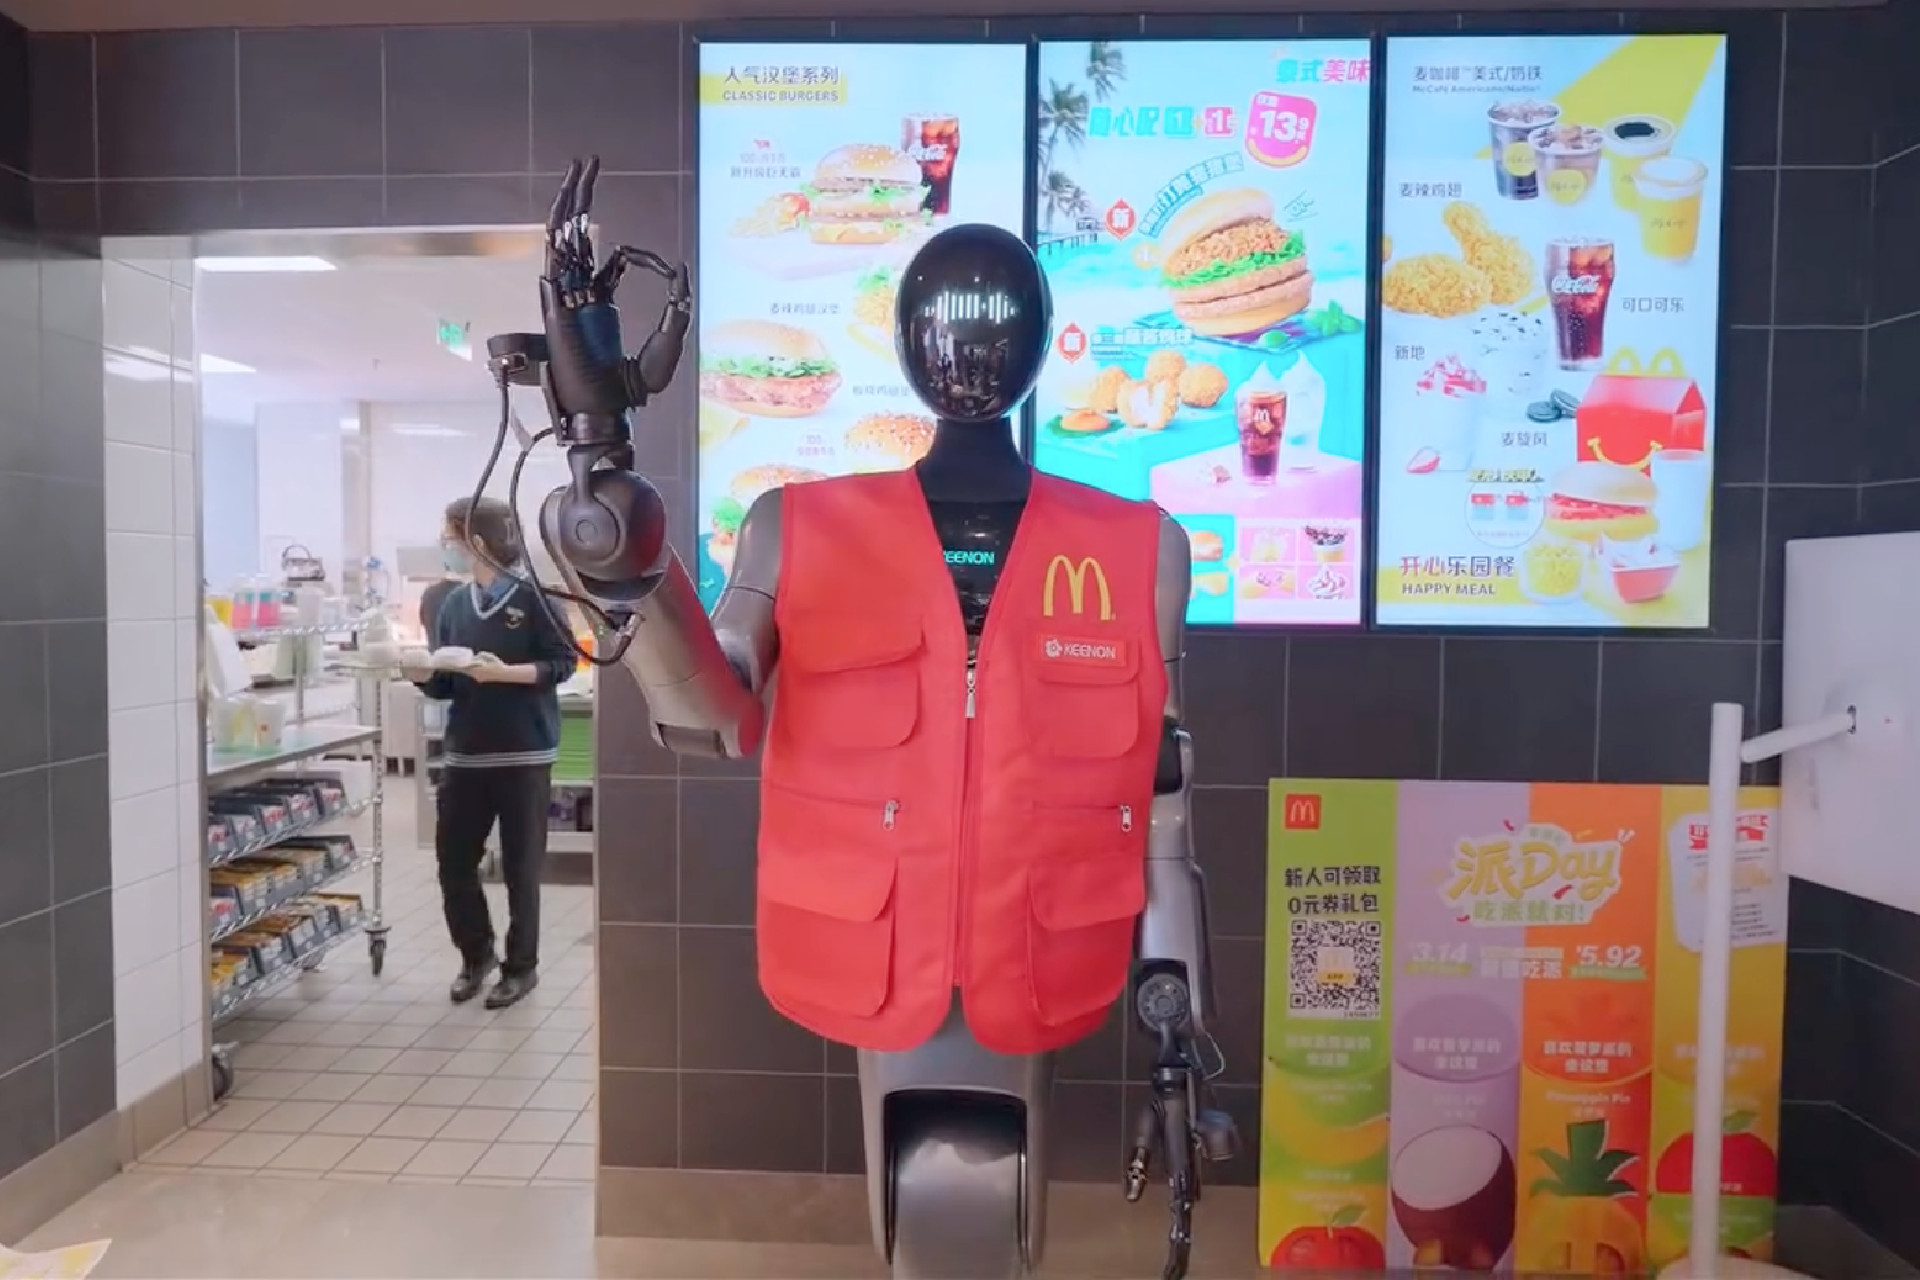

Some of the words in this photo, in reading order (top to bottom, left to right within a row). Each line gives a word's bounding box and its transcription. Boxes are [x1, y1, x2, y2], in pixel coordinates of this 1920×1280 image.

[725, 65, 839, 86] 人气汉堡系列
[722, 90, 776, 102] CLASSIC
[779, 90, 839, 102] BURGERS
[1399, 182, 1462, 198] 麦辣鸡翅
[1622, 297, 1684, 313] 可口可乐
[1395, 345, 1425, 361] 新地
[1502, 432, 1548, 447] 麦旋风
[943, 550, 995, 566] EENON
[1400, 556, 1515, 578] 开心乐园餐
[1402, 583, 1451, 596] HAPPY
[1455, 583, 1496, 596] MEAL
[1063, 642, 1117, 659] KEENON
[1285, 866, 1382, 888] 新人可领取
[1287, 893, 1380, 915] 0元券礼包
